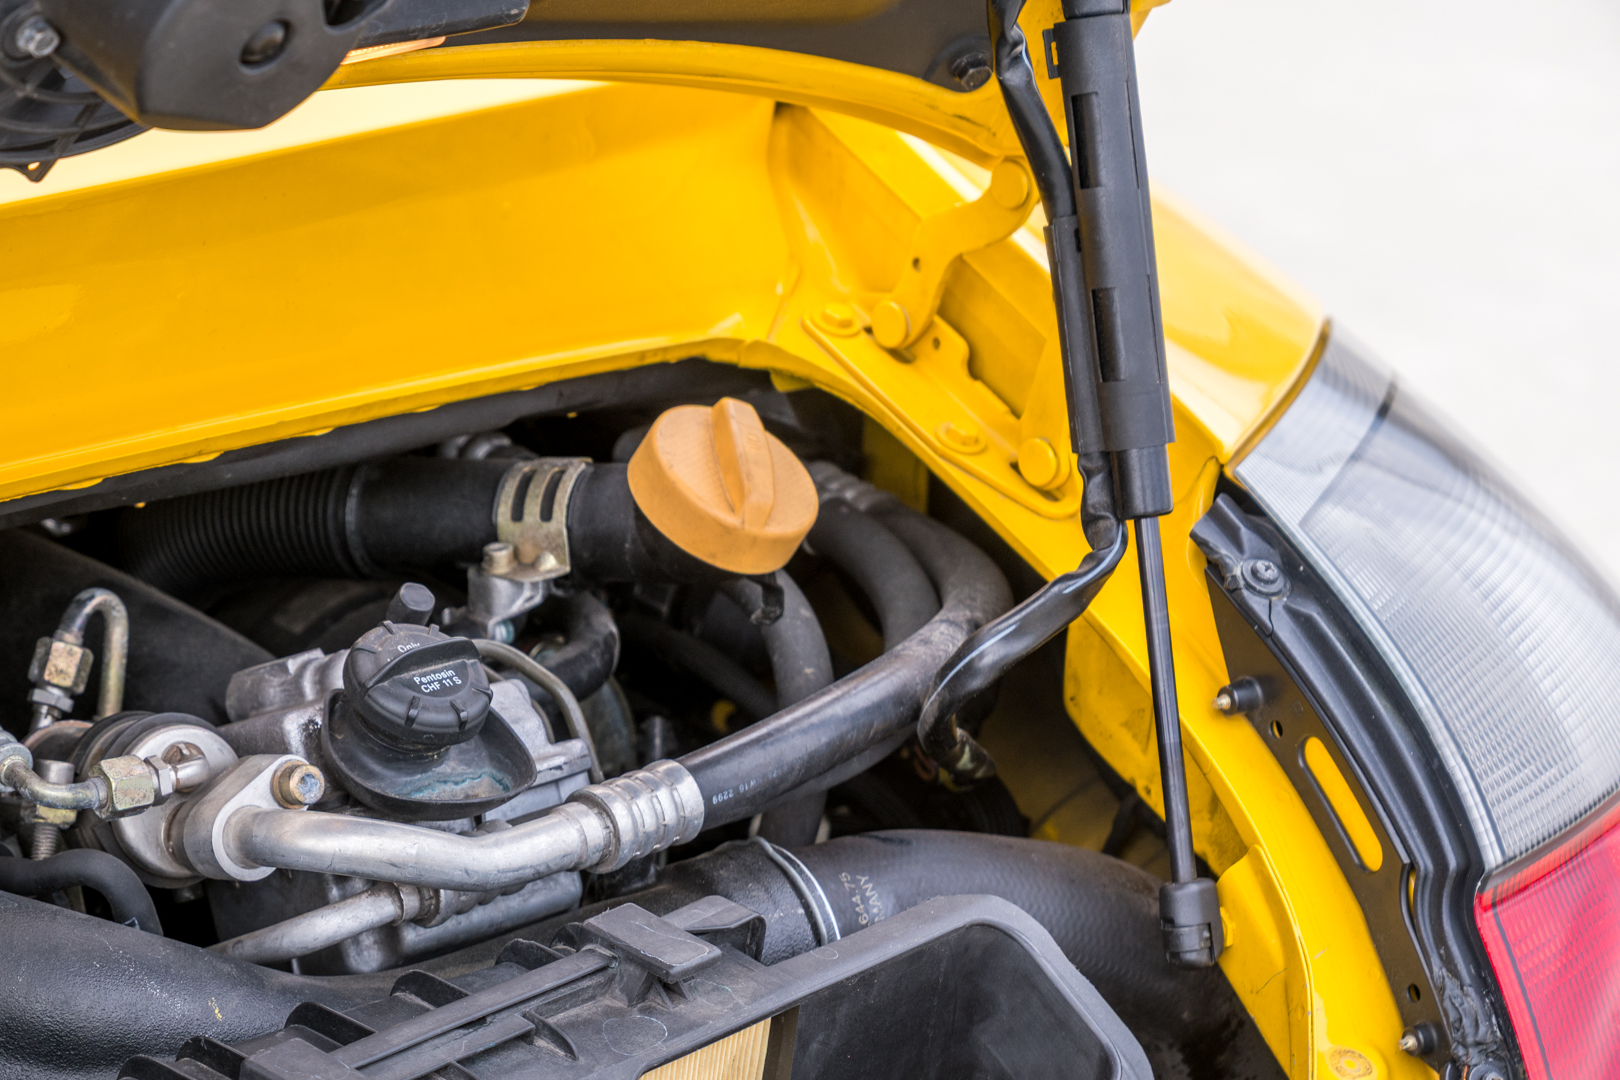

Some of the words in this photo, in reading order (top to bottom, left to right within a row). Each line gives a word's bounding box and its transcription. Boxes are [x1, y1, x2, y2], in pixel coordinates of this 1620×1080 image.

[413, 669, 456, 685] Pentosin
[421, 681, 441, 693] CHF
[442, 678, 454, 687] 11
[452, 676, 462, 685] S
[712, 789, 734, 805] 2299
